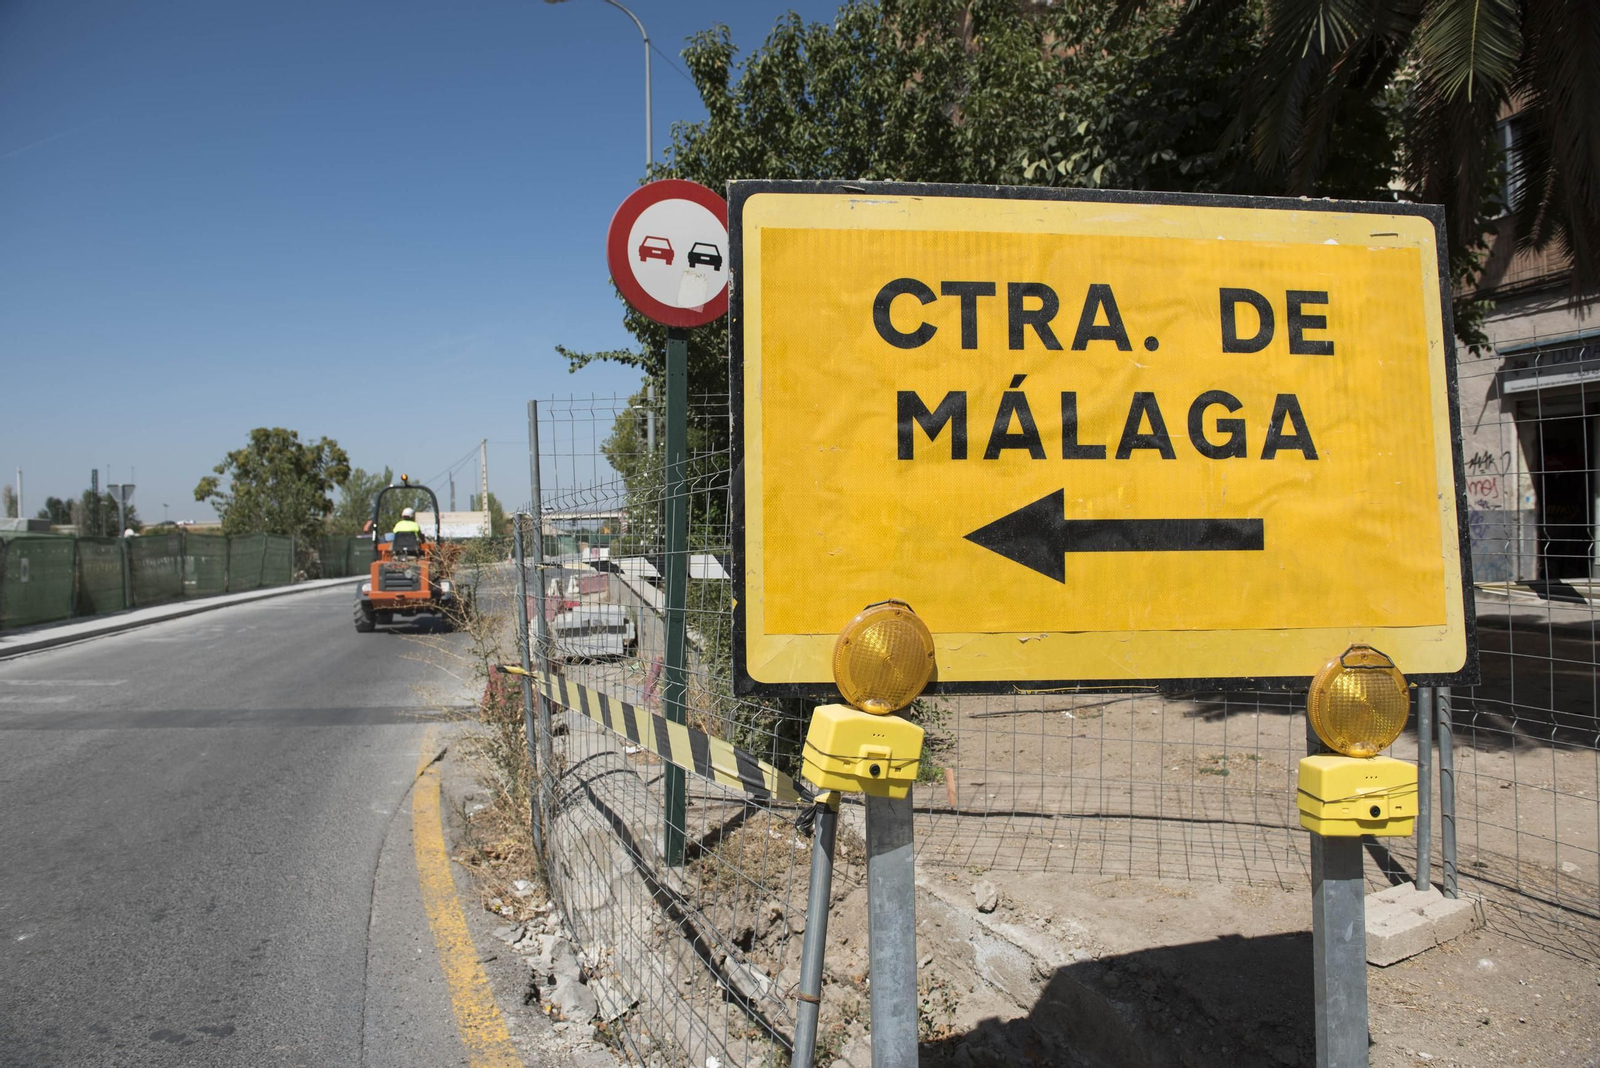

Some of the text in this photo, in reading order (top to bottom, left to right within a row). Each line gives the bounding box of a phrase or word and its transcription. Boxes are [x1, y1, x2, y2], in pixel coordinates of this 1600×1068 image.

[873, 278, 1334, 355] CTRA. DE
[897, 374, 1318, 460] MÁLAGA
